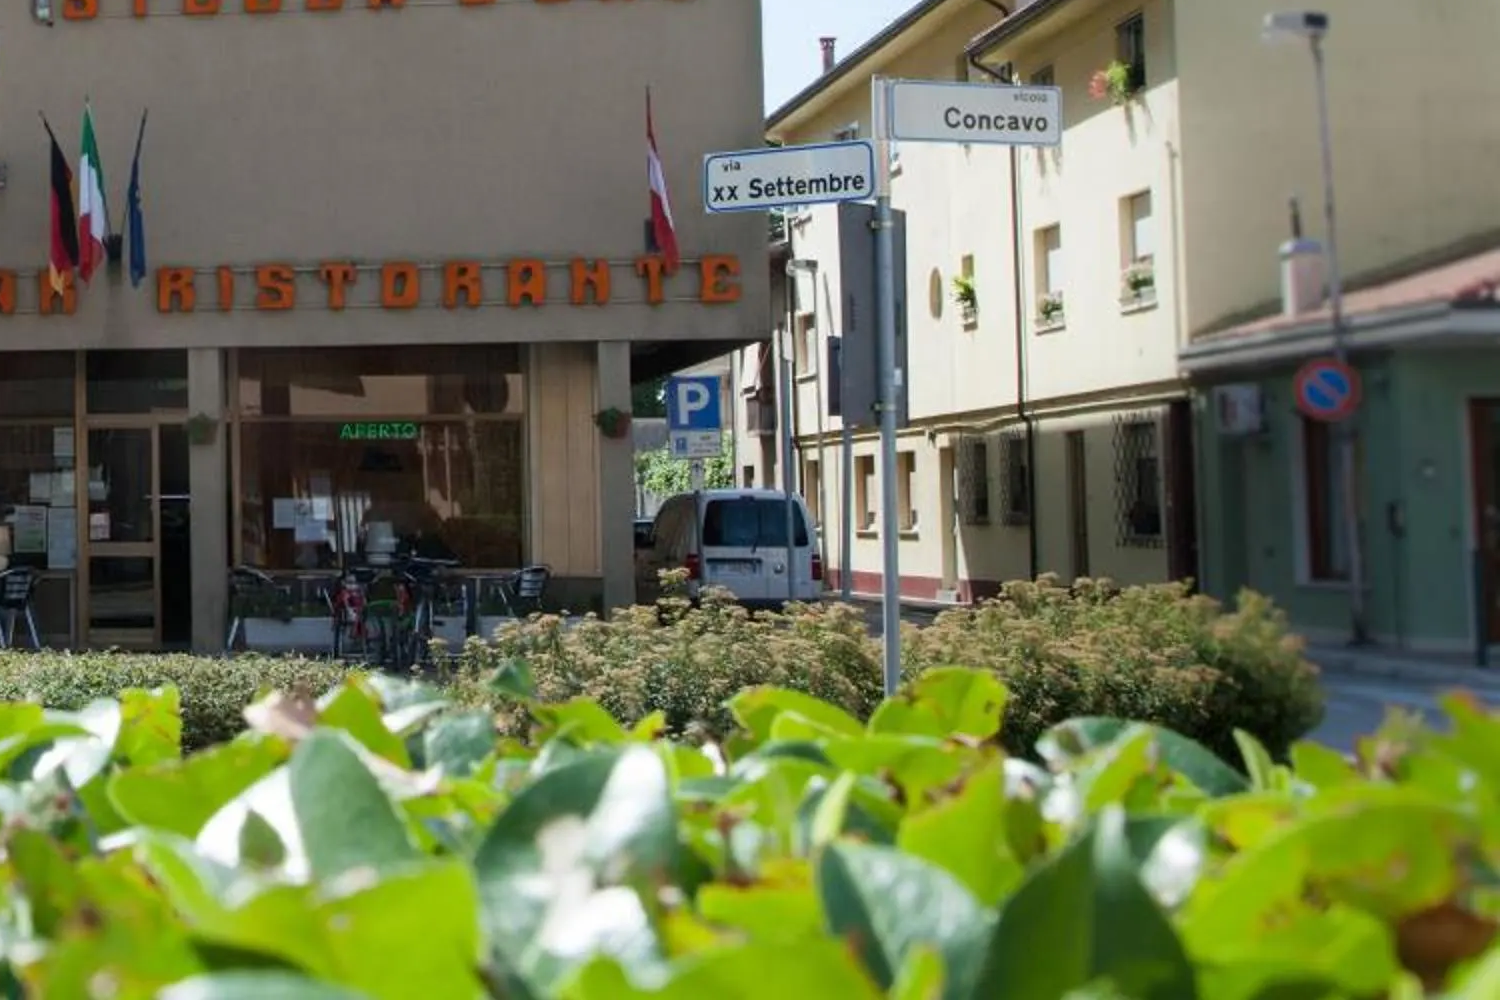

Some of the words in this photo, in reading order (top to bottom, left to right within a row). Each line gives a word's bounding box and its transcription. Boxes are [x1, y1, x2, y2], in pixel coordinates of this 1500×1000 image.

[944, 106, 1048, 132] Concavo
[722, 159, 742, 173] via
[749, 167, 866, 199] Settembre
[156, 255, 742, 314] RISTORANTE
[677, 382, 711, 426] P
[340, 422, 418, 440] APERTO
